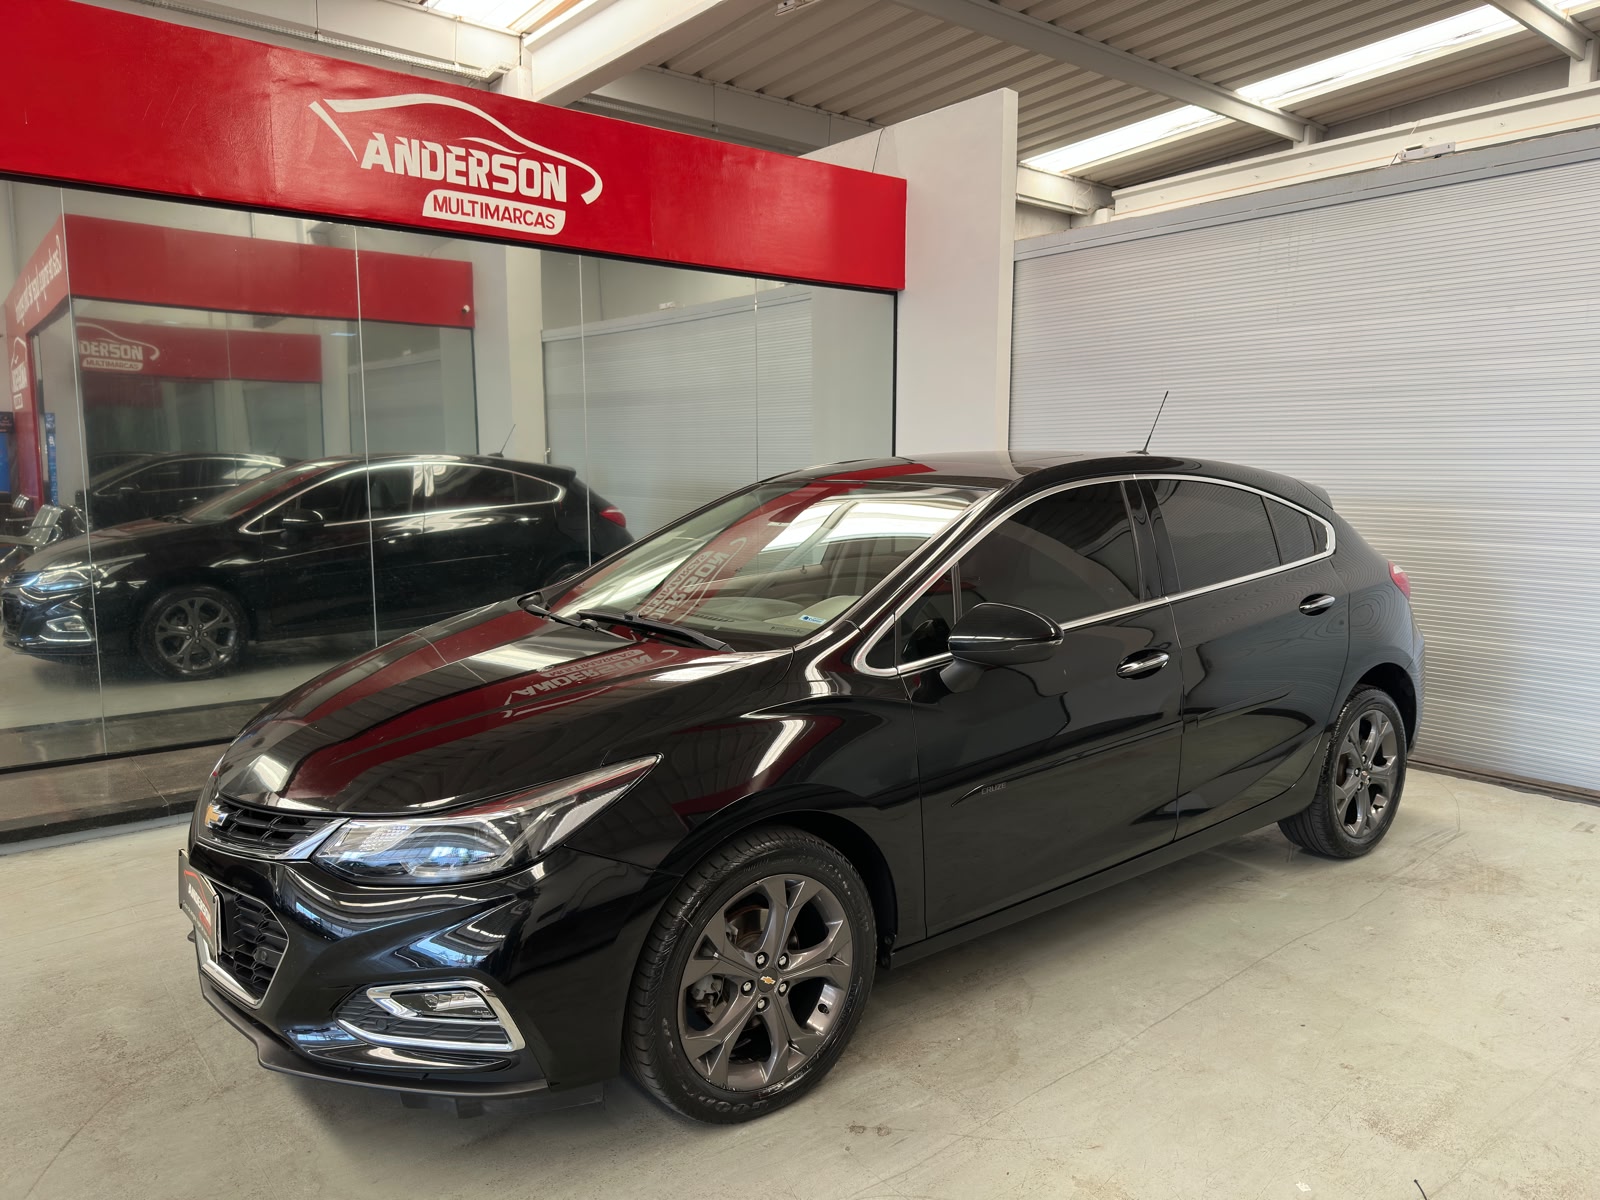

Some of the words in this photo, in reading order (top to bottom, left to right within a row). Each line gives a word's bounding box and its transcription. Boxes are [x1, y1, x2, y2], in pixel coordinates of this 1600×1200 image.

[361, 132, 567, 203] ANDERSON
[433, 194, 556, 230] MULTIMARCAS
[79, 340, 143, 360] DERSON
[981, 783, 1007, 795] CRUZE
